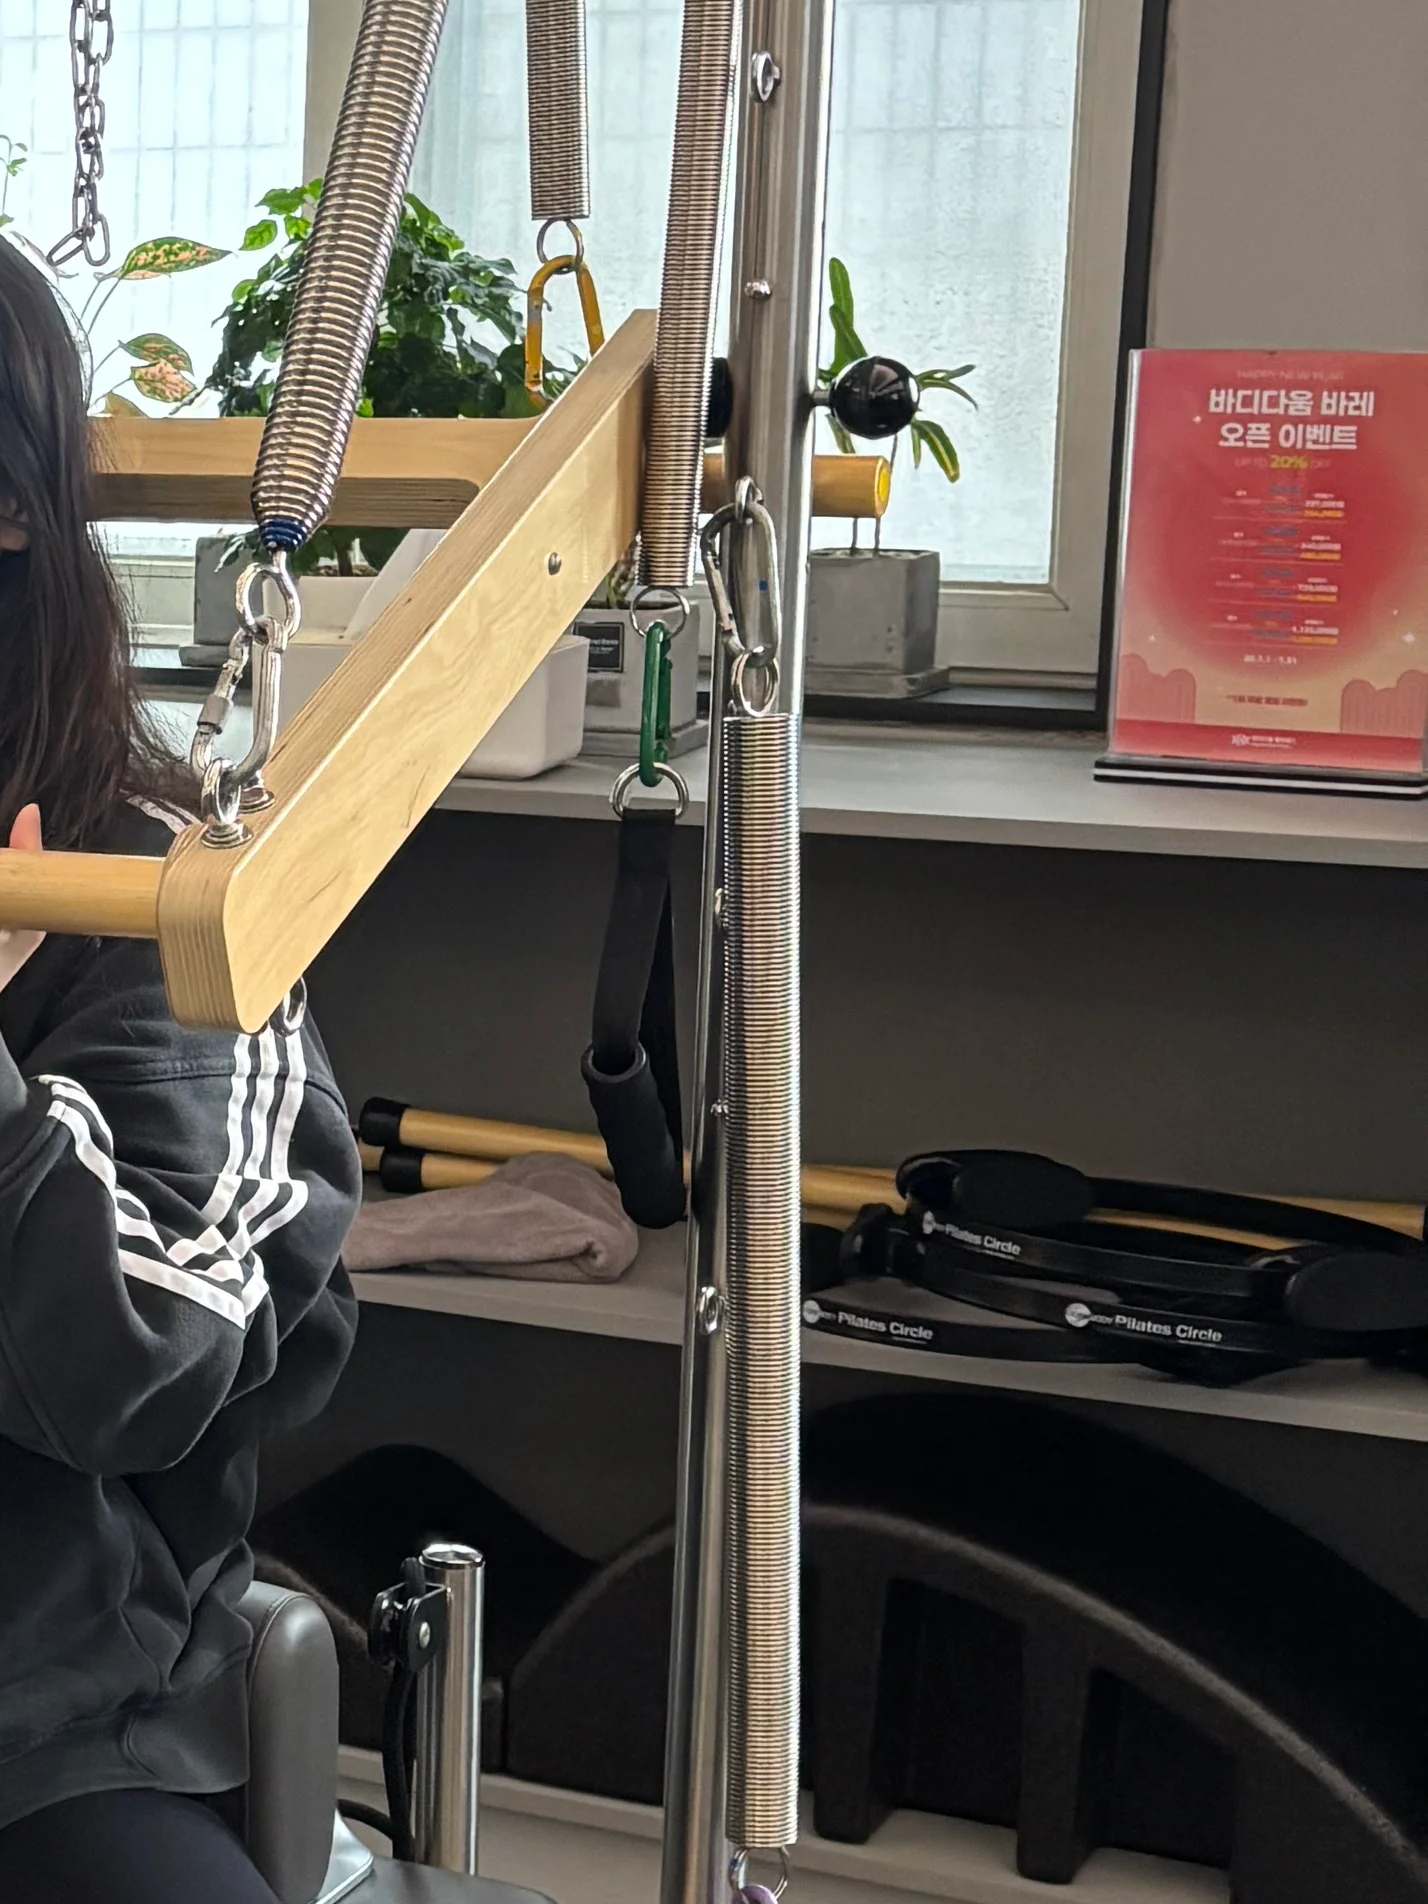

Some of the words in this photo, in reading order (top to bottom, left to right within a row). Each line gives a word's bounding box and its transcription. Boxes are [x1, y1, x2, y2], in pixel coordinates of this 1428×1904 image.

[1208, 388, 1314, 416] 바디다움
[1320, 390, 1375, 417] 바레
[1218, 422, 1271, 448] 오픈
[1278, 423, 1358, 450] 이벤트
[1269, 454, 1309, 469] 20%
[945, 1223, 983, 1246] Pilates
[984, 1235, 1022, 1256] Circle
[838, 1311, 887, 1333] Pilates
[889, 1321, 934, 1340] Circle
[1115, 1314, 1172, 1336] Pilates
[1175, 1324, 1223, 1343] Circle
